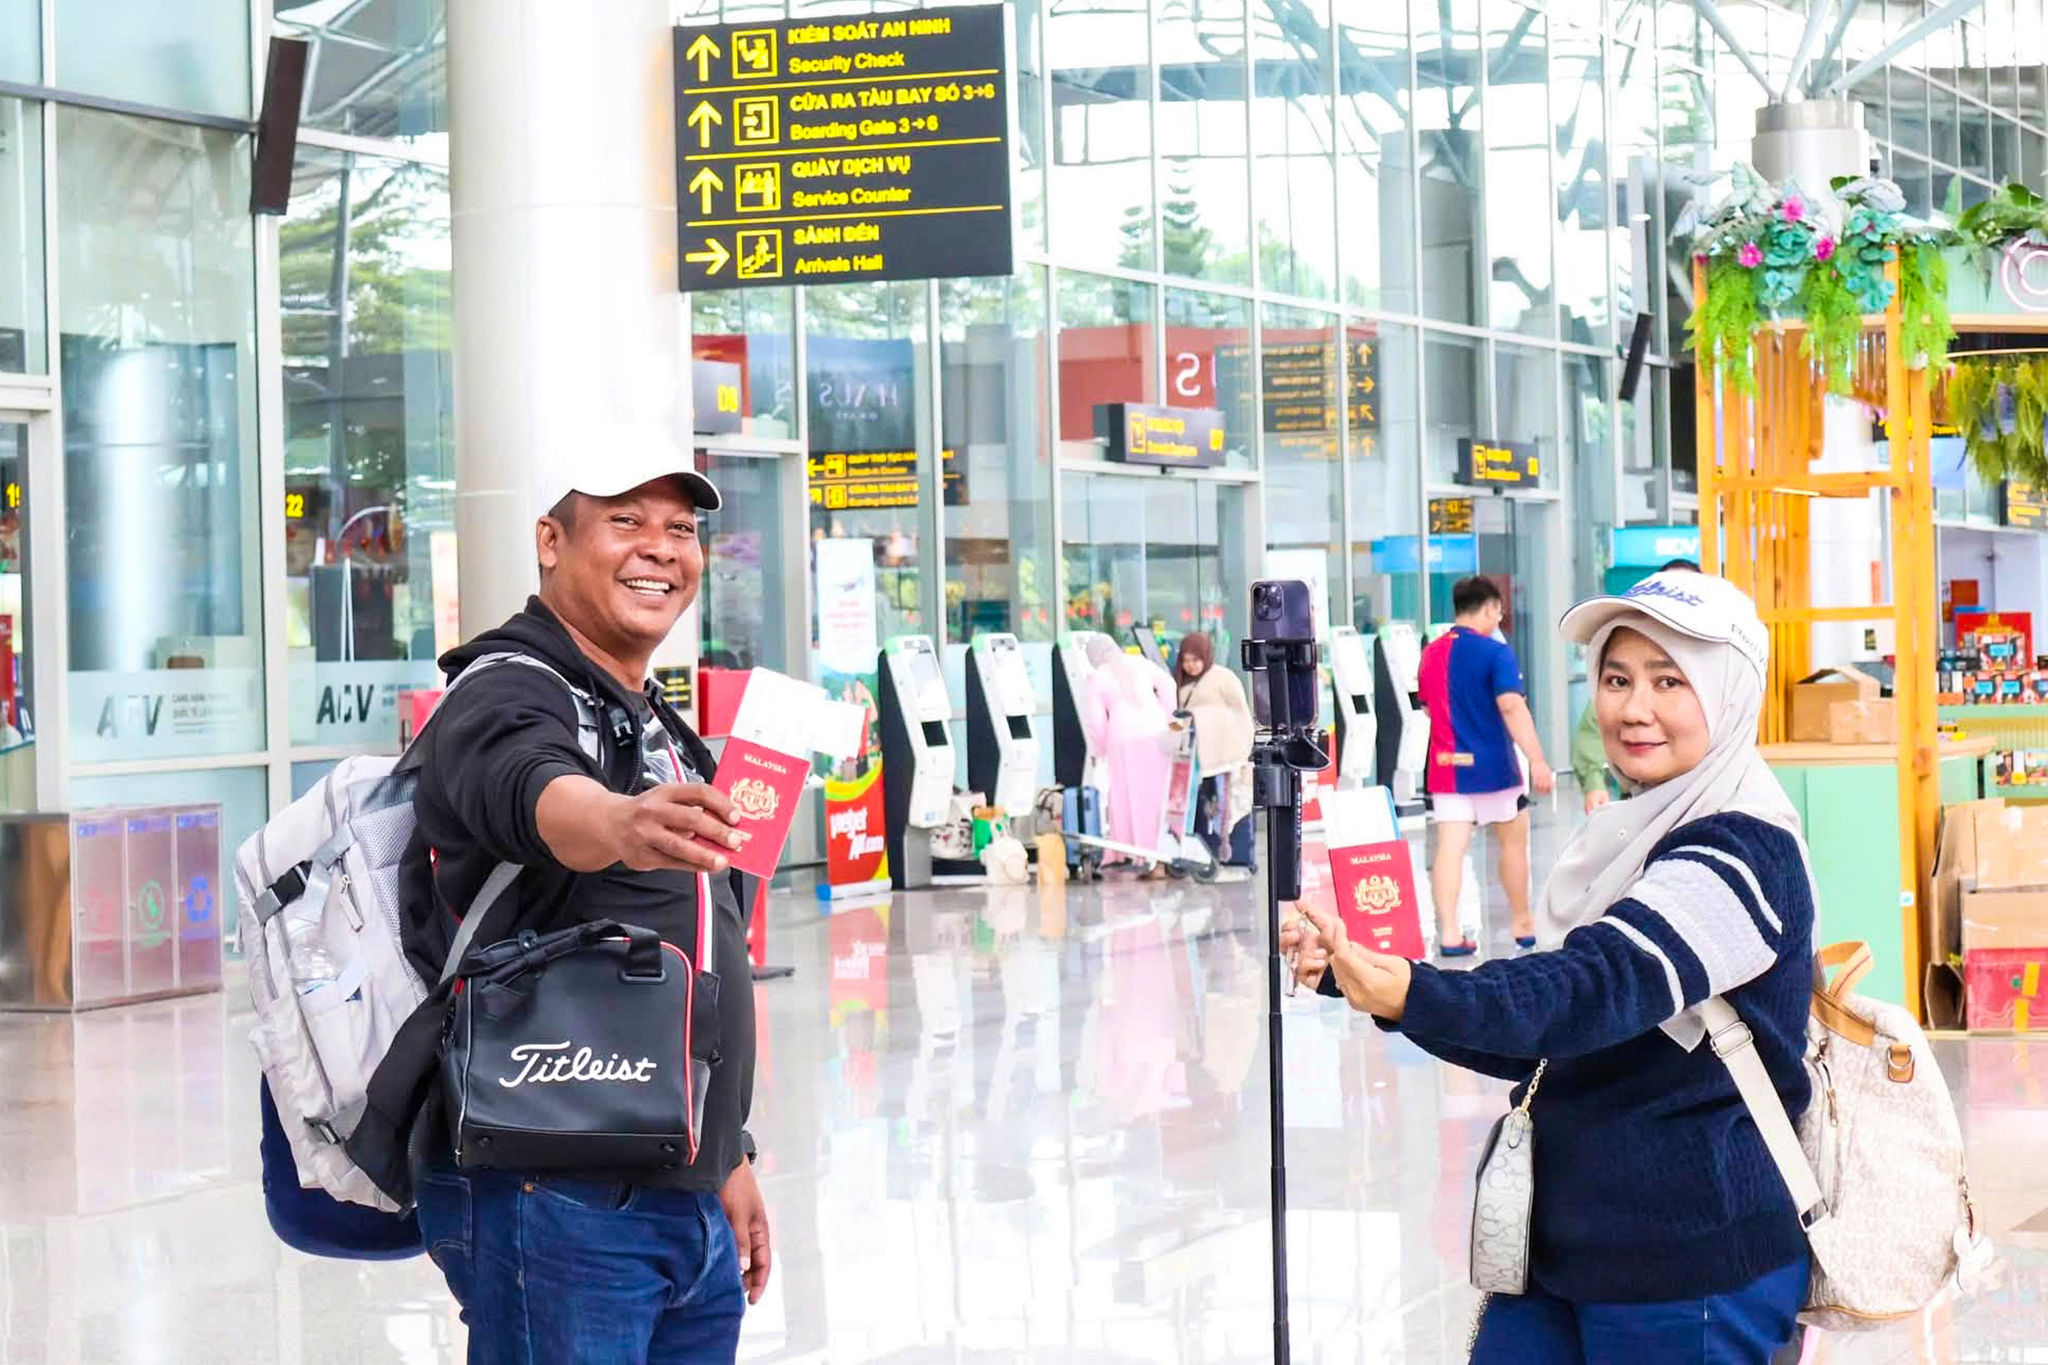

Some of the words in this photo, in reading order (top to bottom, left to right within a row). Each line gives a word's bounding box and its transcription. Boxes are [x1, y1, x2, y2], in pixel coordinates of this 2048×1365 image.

[881, 20, 907, 38] AN
[908, 17, 951, 35] NINH
[788, 54, 852, 74] Security
[854, 51, 905, 69] Check
[830, 92, 857, 109] RA
[896, 86, 932, 105] BAY
[790, 121, 858, 141] Boarding
[859, 119, 897, 136] Gate
[842, 156, 884, 178] DỊCH
[885, 155, 911, 175] VỤ
[792, 189, 849, 208] Service
[850, 187, 912, 204] Counter
[794, 256, 851, 274] Arrivals
[853, 254, 884, 271] Hall
[286, 494, 304, 518] 22
[97, 695, 165, 738] AV
[743, 753, 787, 775] MALAYSIA
[1350, 853, 1392, 865] MALAYSIA
[499, 1040, 657, 1088] Titleist
